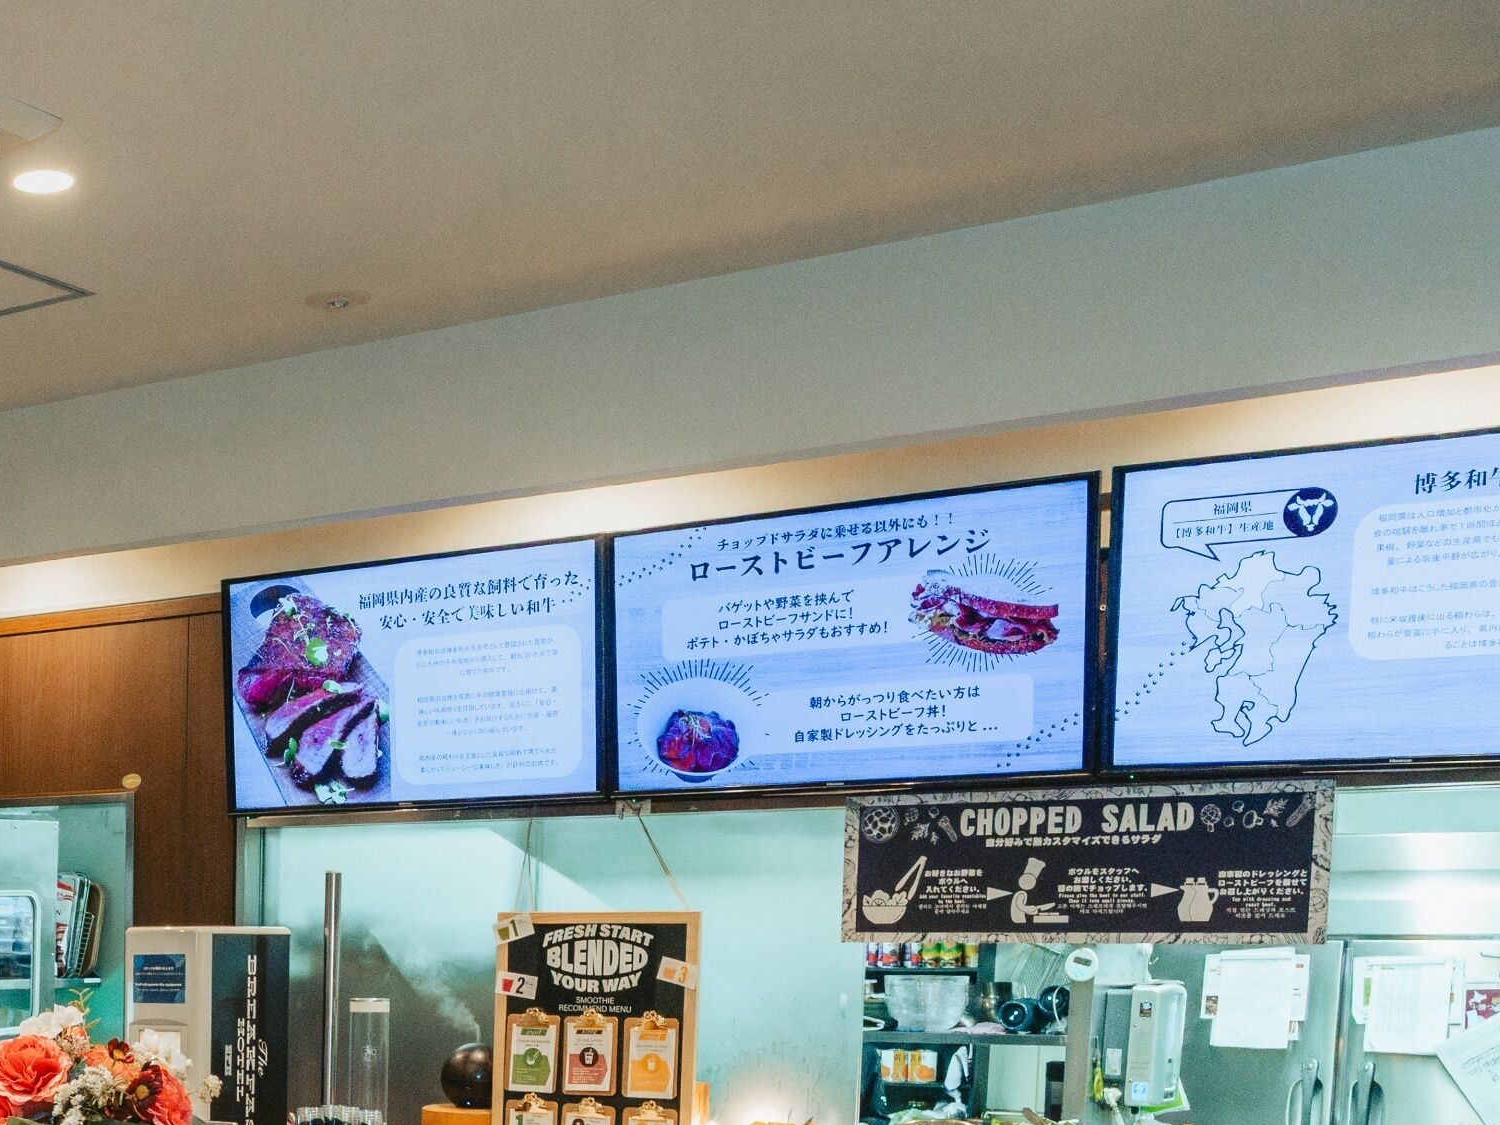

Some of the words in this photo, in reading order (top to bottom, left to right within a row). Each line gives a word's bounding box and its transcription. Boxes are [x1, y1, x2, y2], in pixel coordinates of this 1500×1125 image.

[1214, 500, 1252, 515] 福岡県
[691, 529, 991, 581] ローストビーフアレンジ
[359, 570, 579, 610] 福岡県内産の良質な飼料で育った
[719, 589, 854, 613] バゲットや野菜を挟んで
[379, 597, 556, 630] 安心・安全で美味しい和牛
[810, 685, 981, 709] 朝からがっつり食べたい方は
[960, 805, 1082, 837] CHOPPED
[1101, 802, 1195, 834] SALAD
[510, 919, 518, 937] 1
[542, 923, 598, 948] FRESH
[598, 923, 654, 947] START
[546, 939, 649, 976] BLENDED
[515, 976, 526, 995] 2
[550, 969, 600, 993] YOUR
[601, 971, 642, 993] WAY
[678, 965, 690, 984] 3
[558, 1004, 608, 1013] RECOMMEND
[608, 1005, 632, 1013] MENU
[575, 996, 615, 1004] SMOOTHIE
[236, 1017, 245, 1103] HOTEL
[258, 1038, 268, 1078] The
